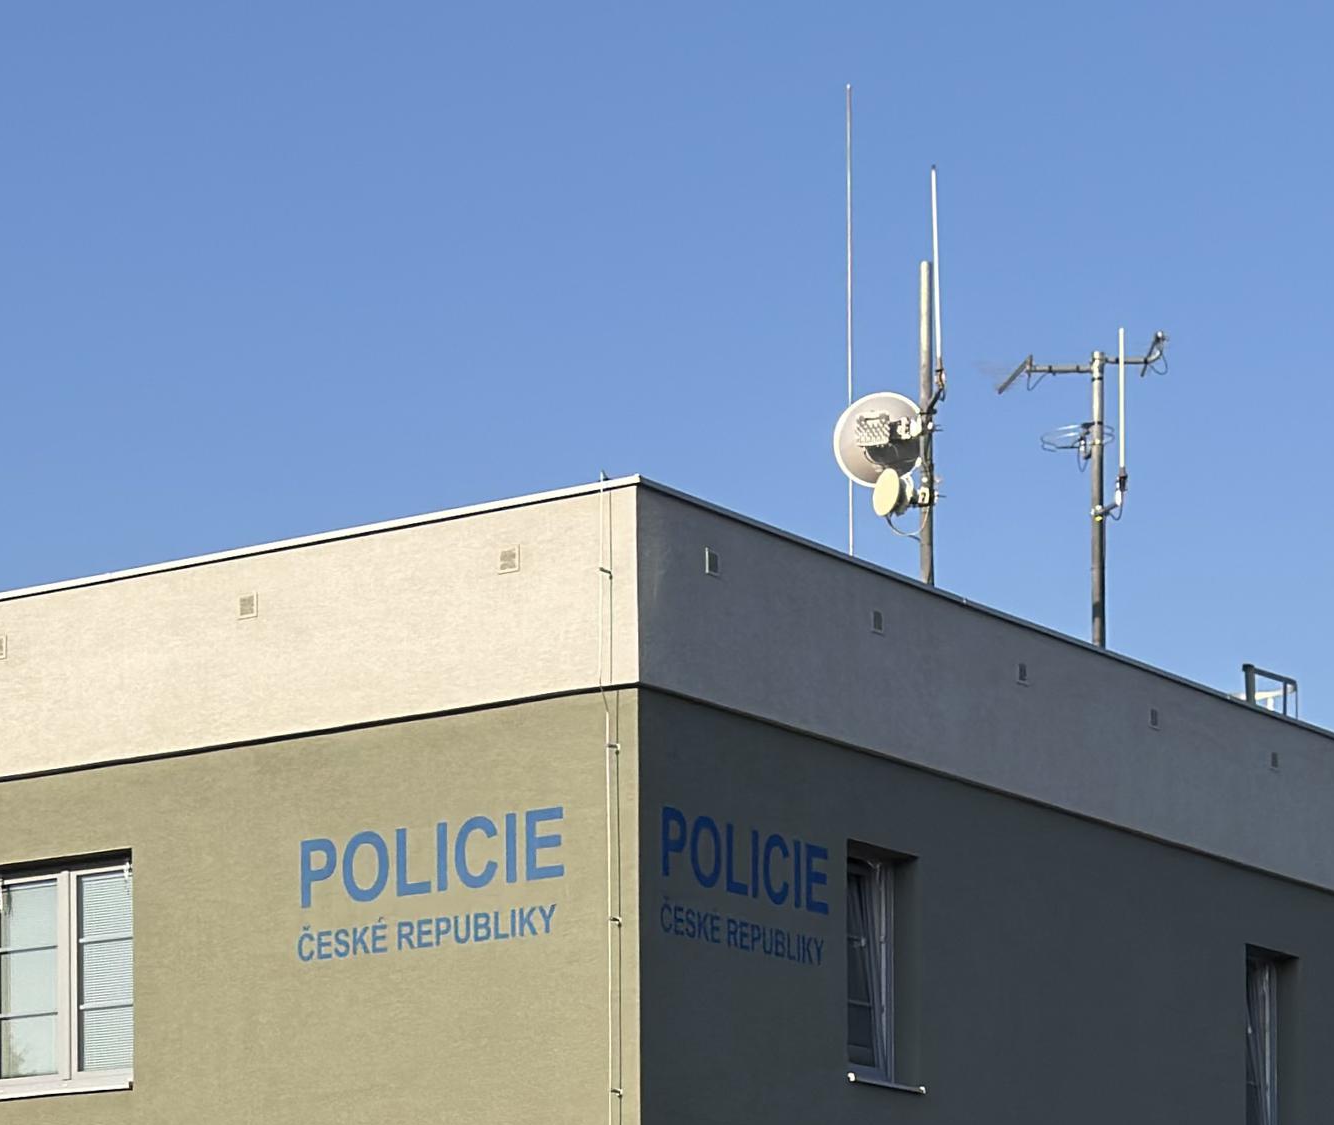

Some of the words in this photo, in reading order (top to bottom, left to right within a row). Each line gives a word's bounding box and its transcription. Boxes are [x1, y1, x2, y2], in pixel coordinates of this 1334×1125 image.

[300, 806, 564, 908] POLICIE
[660, 806, 829, 915] POLICIE
[297, 916, 387, 961] ČESKÉ
[396, 903, 556, 950] REPUBLIKY
[660, 895, 720, 944] ČESKÉ
[727, 918, 824, 965] REPUBLIKY
